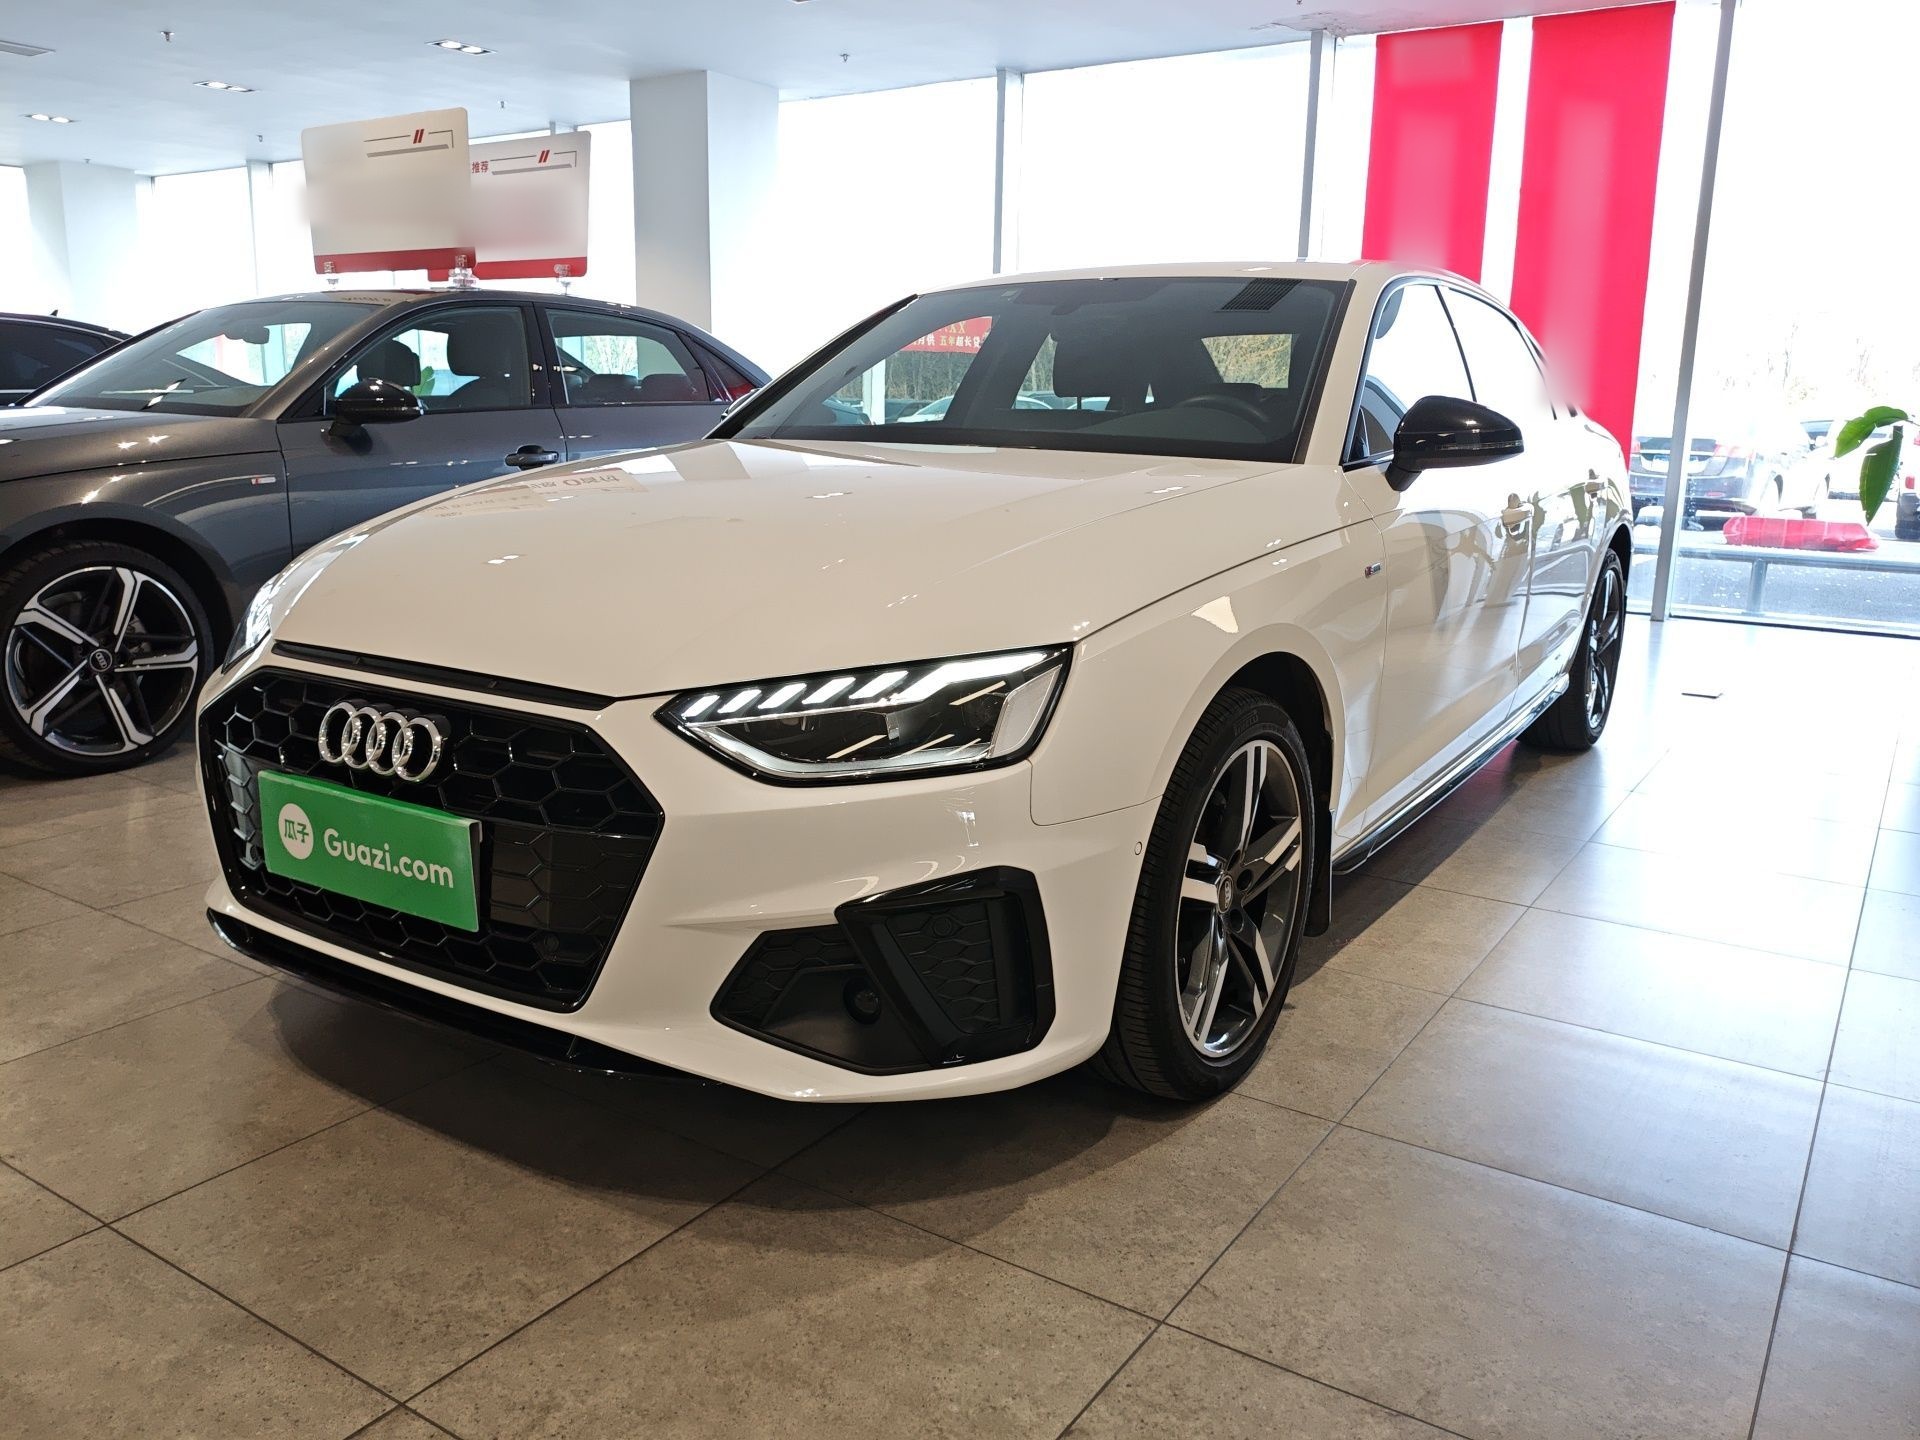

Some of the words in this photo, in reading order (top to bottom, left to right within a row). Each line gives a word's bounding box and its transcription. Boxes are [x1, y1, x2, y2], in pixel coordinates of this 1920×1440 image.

[471, 160, 489, 174] 推荐
[940, 333, 986, 348] 五年超长贷
[284, 819, 309, 843] 瓜子
[323, 828, 454, 889] Guazi.com
